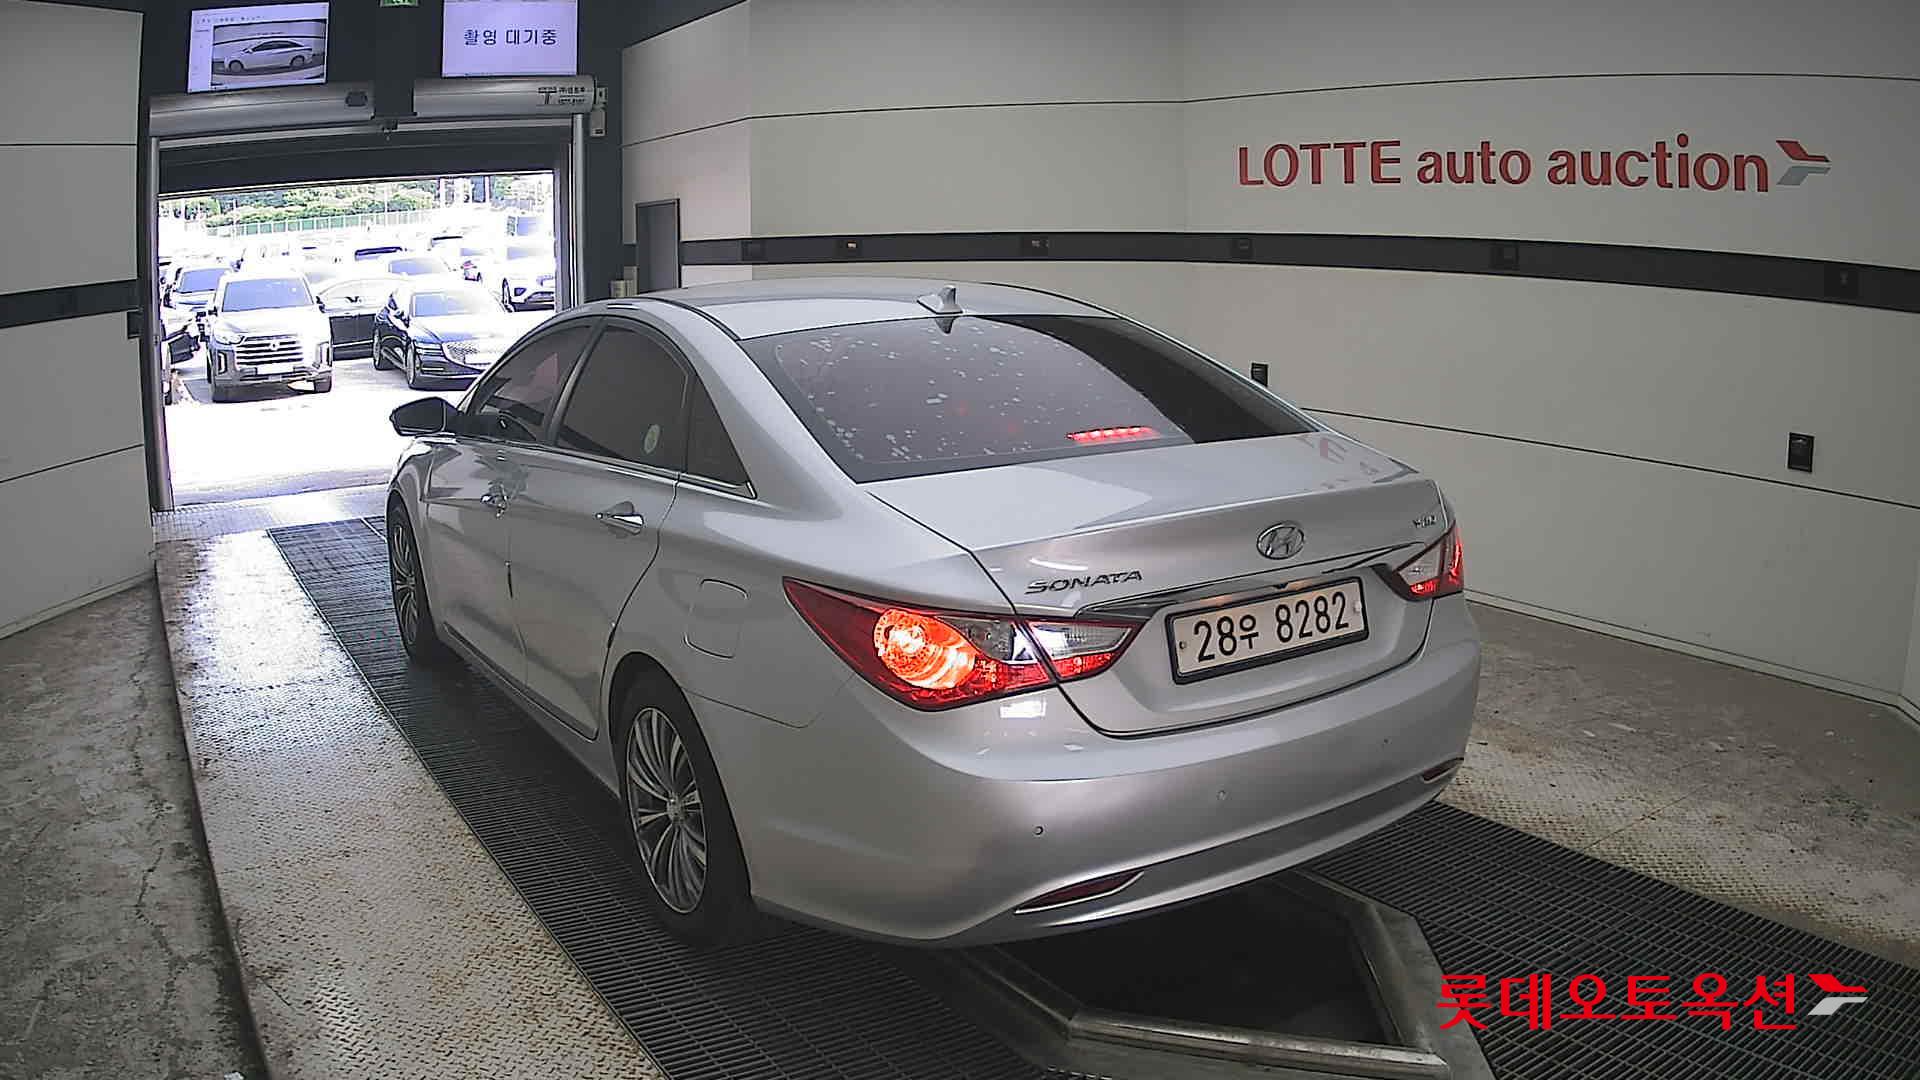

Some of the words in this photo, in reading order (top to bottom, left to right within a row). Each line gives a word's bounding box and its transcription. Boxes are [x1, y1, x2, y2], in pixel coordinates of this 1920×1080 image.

[505, 29, 558, 46] 대기중
[1238, 139, 1401, 186] LOTTE
[1416, 140, 1531, 186] auto
[1546, 132, 1769, 193] auction
[1024, 570, 1142, 595] SONATA
[1193, 613, 1259, 663] 28우
[1274, 591, 1350, 643] 8282
